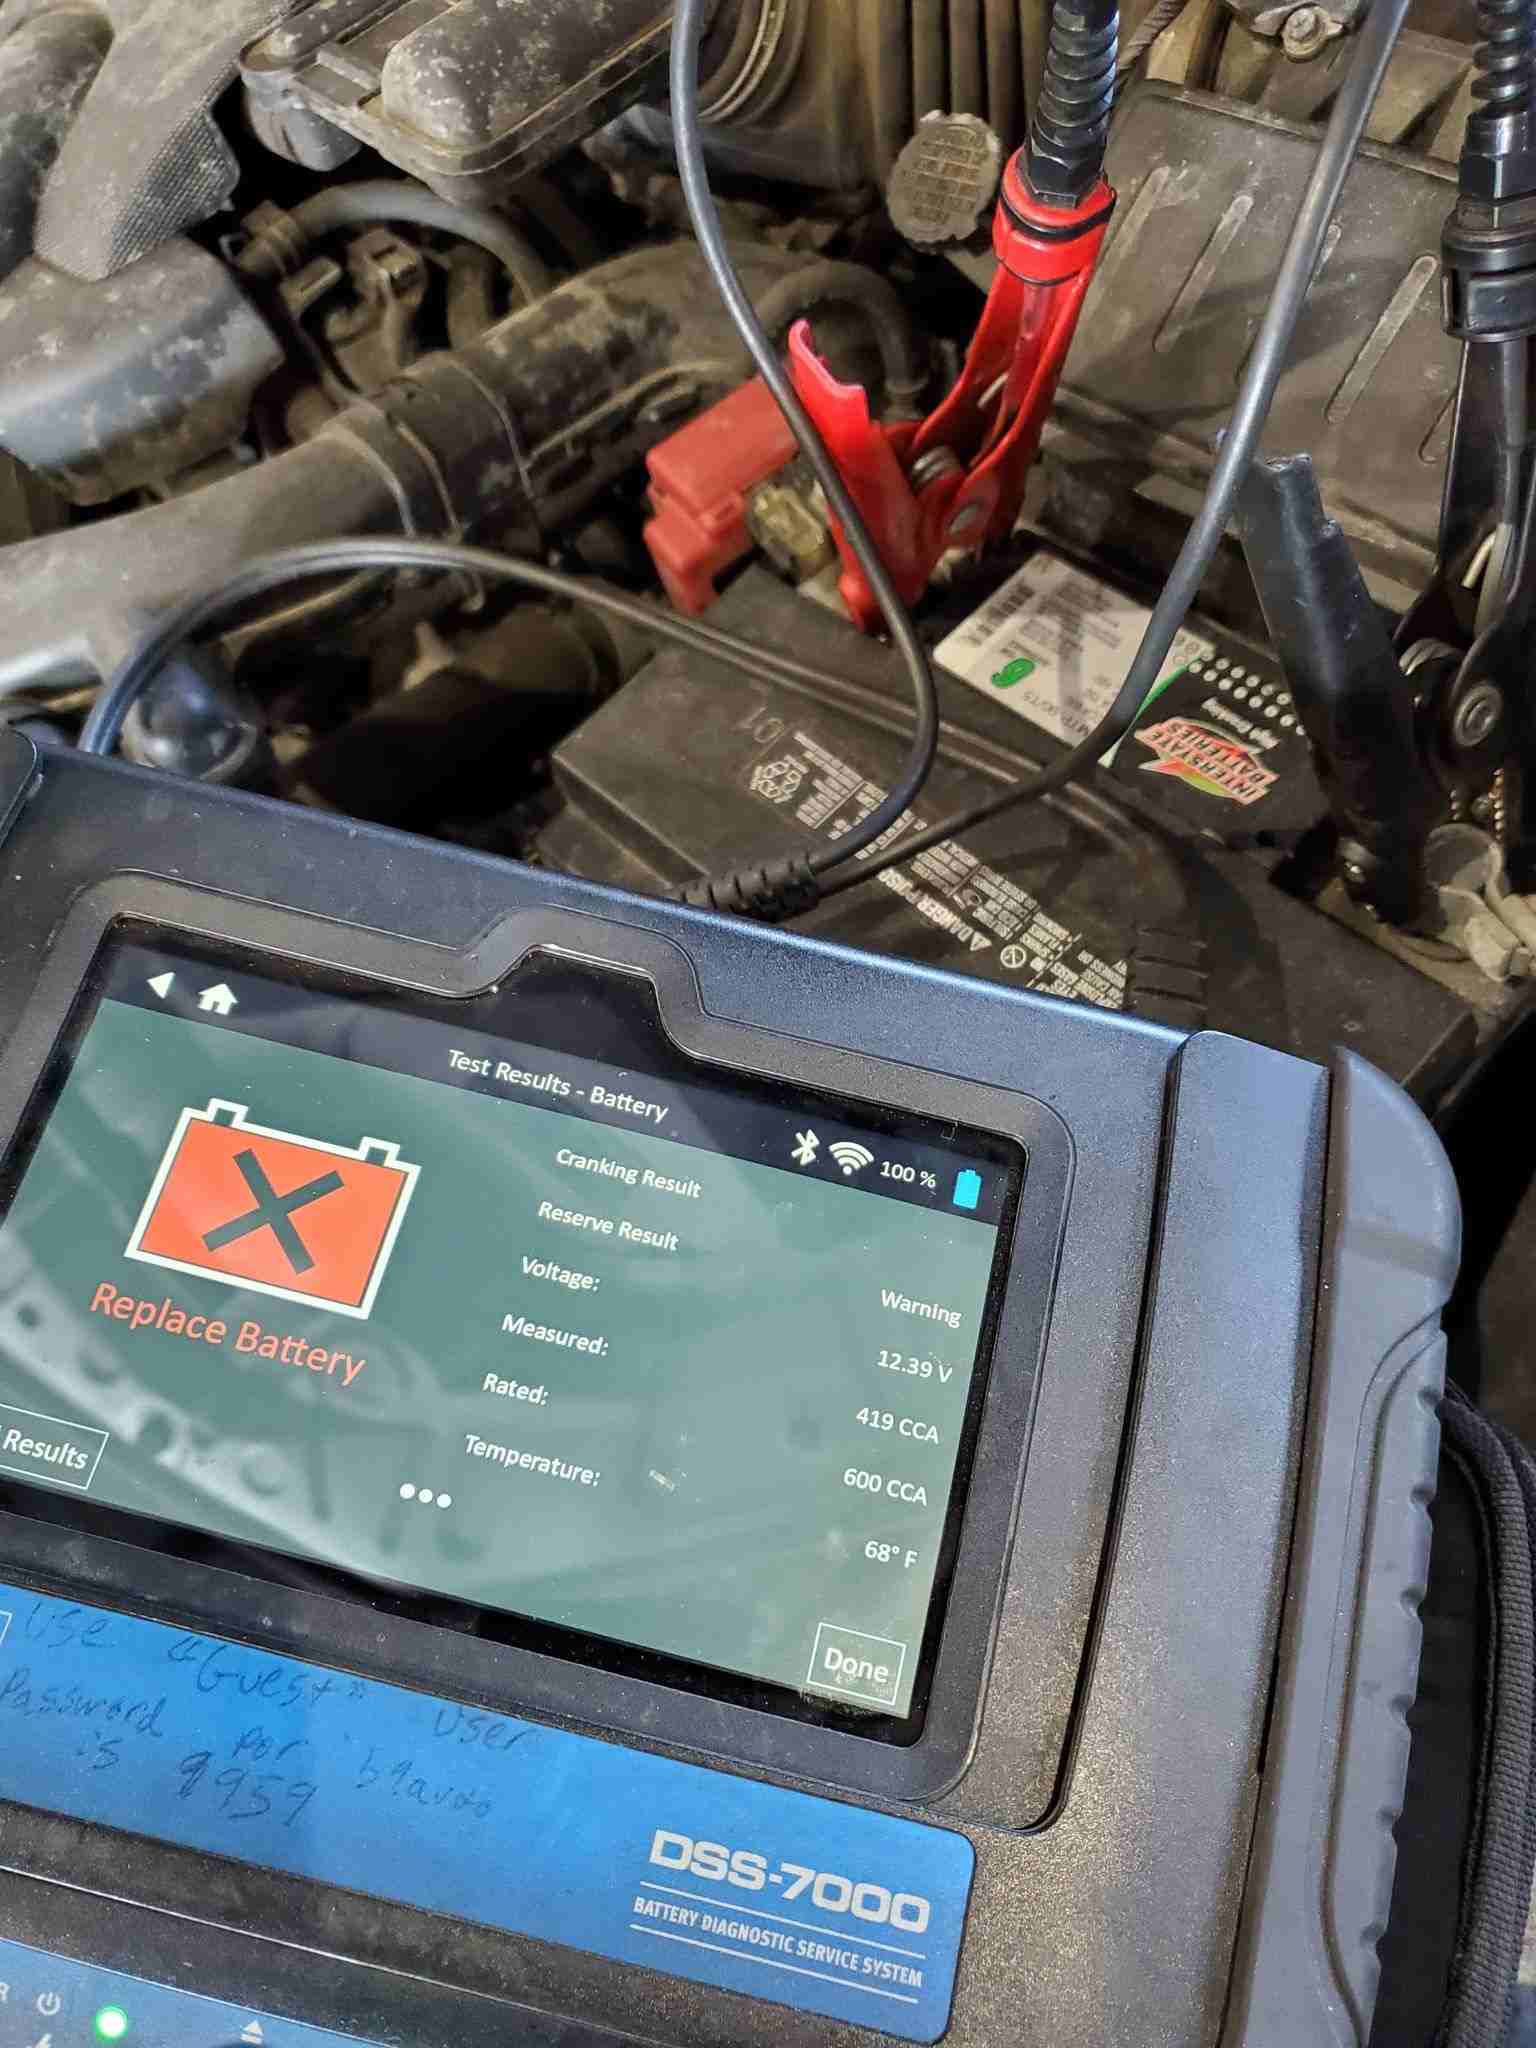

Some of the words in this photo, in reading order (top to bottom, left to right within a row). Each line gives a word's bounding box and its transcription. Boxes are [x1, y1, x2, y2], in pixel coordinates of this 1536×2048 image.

[449, 1049, 492, 1076] Test
[495, 1062, 571, 1095] Results
[590, 1086, 669, 1123] Battery
[556, 1149, 638, 1184] Cranking
[642, 1170, 701, 1198] Result
[880, 1161, 915, 1182] 100
[920, 1171, 936, 1189] %
[538, 1201, 613, 1234] Reserve
[618, 1221, 678, 1250] Result
[523, 1256, 600, 1291] Voltage:
[882, 1289, 961, 1328] Warning
[90, 1281, 227, 1344] Replace
[235, 1321, 366, 1386] Battery
[502, 1314, 608, 1356] Measured:
[878, 1350, 933, 1377] 12.39
[939, 1365, 952, 1382] V
[483, 1373, 548, 1405] Rated:
[856, 1408, 893, 1430] 419
[900, 1419, 938, 1444] CCA
[2, 1428, 89, 1470] Results
[466, 1435, 600, 1486] Temperature:
[844, 1468, 881, 1492] 600
[887, 1480, 926, 1506] CCA
[905, 1550, 917, 1568] F
[824, 1648, 888, 1684] Done
[649, 1829, 931, 1934] DSS-7000
[632, 1896, 698, 1927] BATTERY
[700, 1915, 793, 1954] DIAGNOSTIC
[796, 1939, 859, 1971] SERVICE
[861, 1957, 923, 1989] SYSTEM
